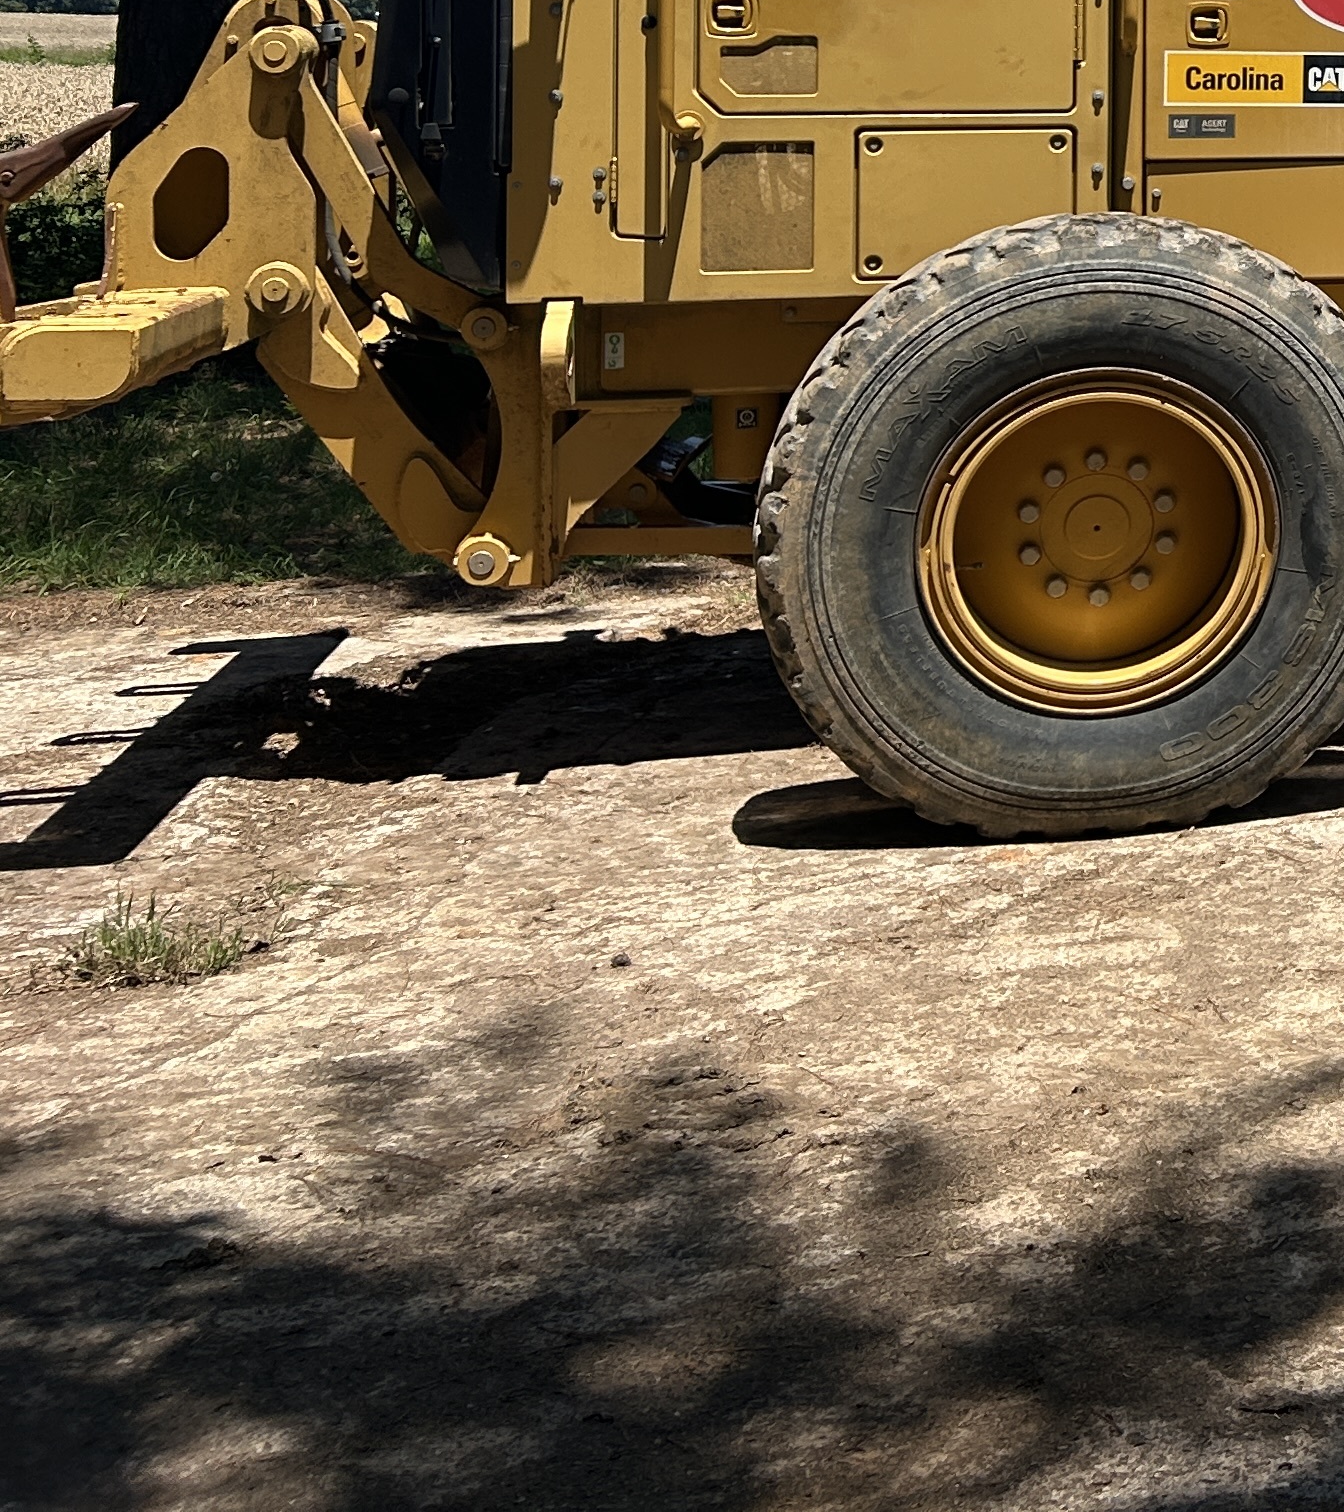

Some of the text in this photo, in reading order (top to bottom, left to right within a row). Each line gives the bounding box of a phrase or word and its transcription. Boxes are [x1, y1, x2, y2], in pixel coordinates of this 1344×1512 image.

[1185, 66, 1284, 91] Carolina
[1173, 119, 1190, 129] CAT
[1121, 308, 1302, 406] 17.5R25
[858, 325, 1028, 502] MAXAM
